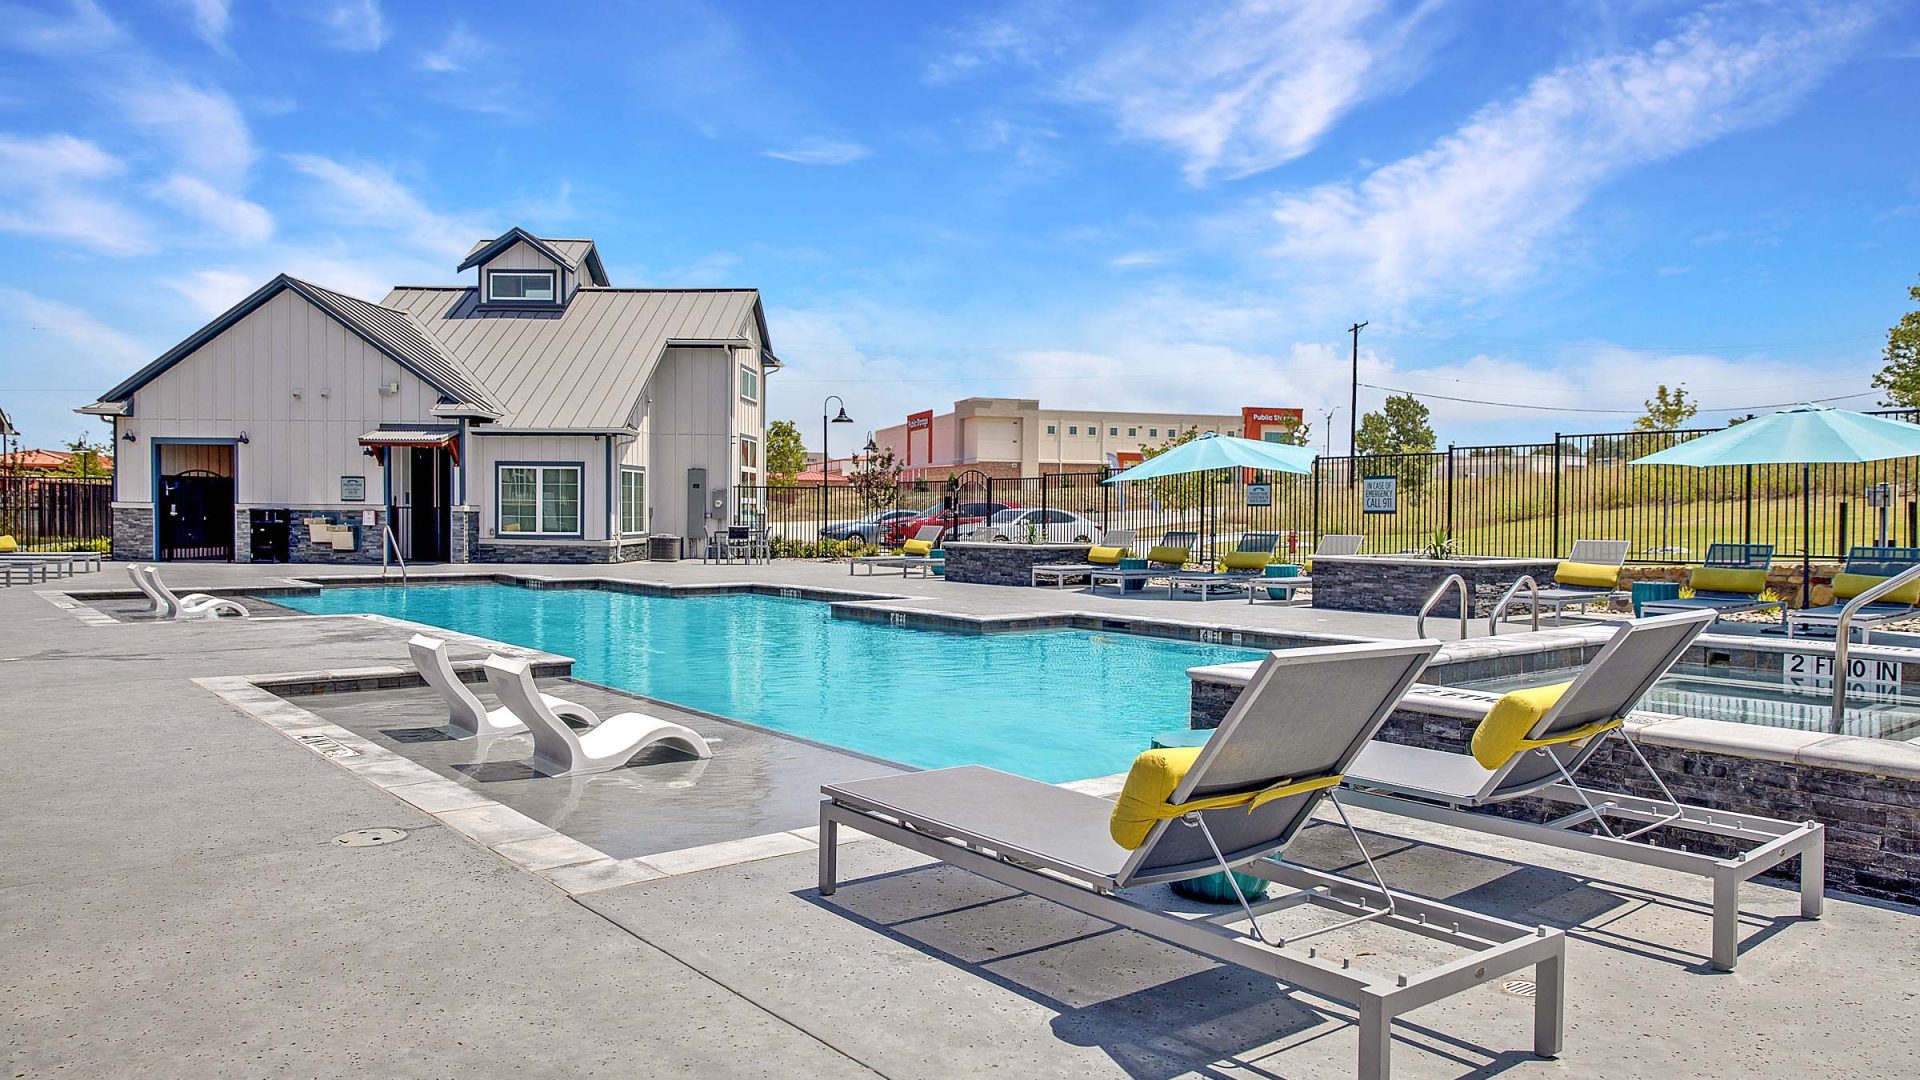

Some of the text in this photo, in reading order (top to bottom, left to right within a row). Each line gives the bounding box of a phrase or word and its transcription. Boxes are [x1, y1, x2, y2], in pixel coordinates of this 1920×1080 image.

[1253, 413, 1272, 421] Public
[1367, 498, 1392, 508] CALL 911
[1790, 654, 1804, 673] 2
[1876, 661, 1898, 682] IN
